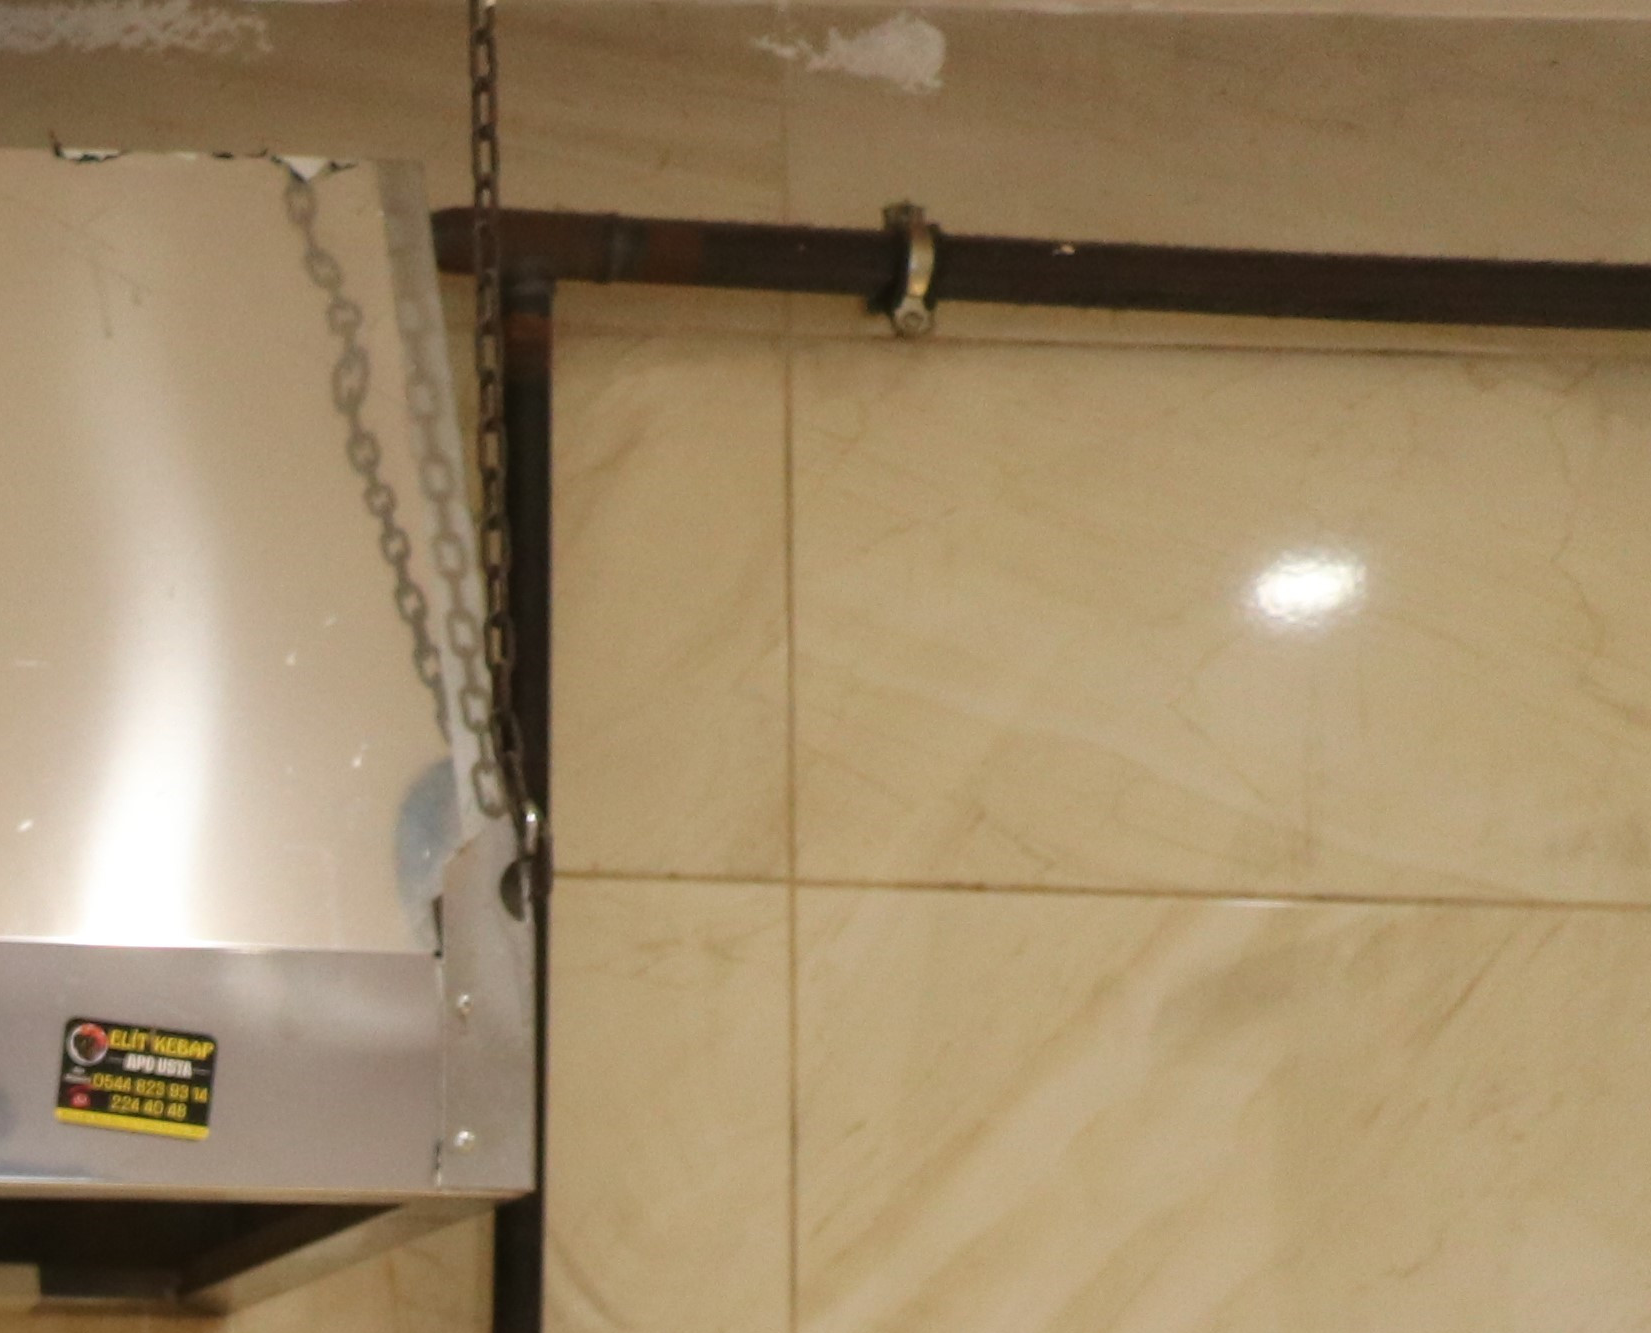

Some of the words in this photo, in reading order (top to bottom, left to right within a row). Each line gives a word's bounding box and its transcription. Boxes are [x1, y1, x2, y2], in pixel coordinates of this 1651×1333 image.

[109, 1029, 148, 1051] ELİT
[152, 1035, 215, 1060] KEBAP
[92, 1072, 132, 1092] 0544
[110, 1095, 140, 1113] 224
